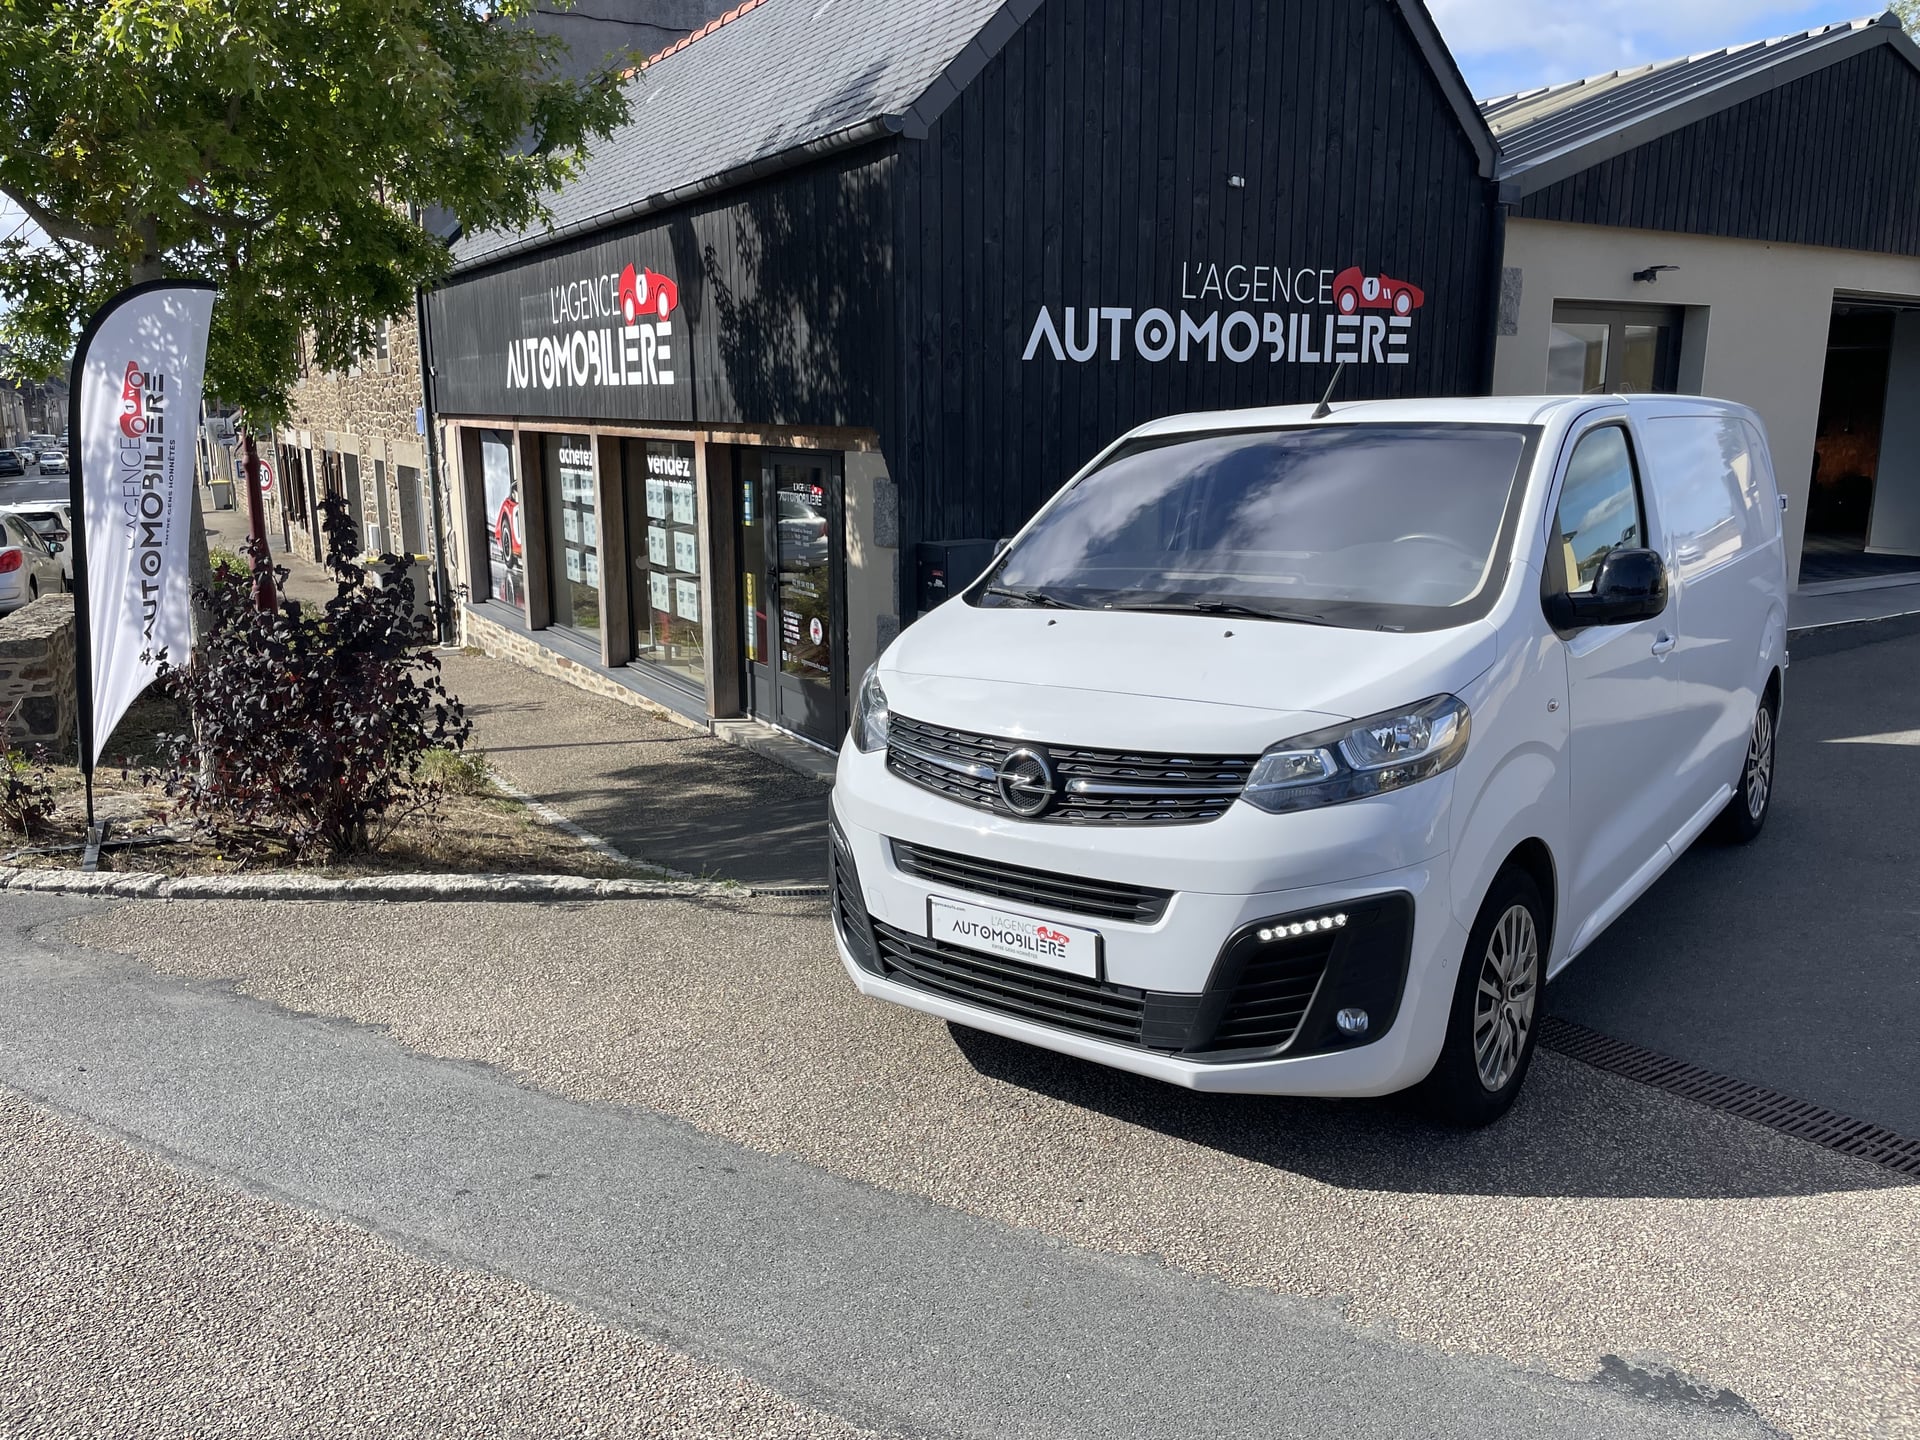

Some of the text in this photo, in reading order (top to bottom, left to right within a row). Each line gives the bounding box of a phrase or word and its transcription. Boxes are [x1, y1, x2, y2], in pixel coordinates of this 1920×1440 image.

[550, 273, 621, 324] L'AGENCE
[1182, 261, 1334, 305] L'AGENCE
[646, 449, 690, 477] vendez
[119, 437, 142, 550] L'AGENCE
[991, 915, 1038, 936] L'AGENCE
